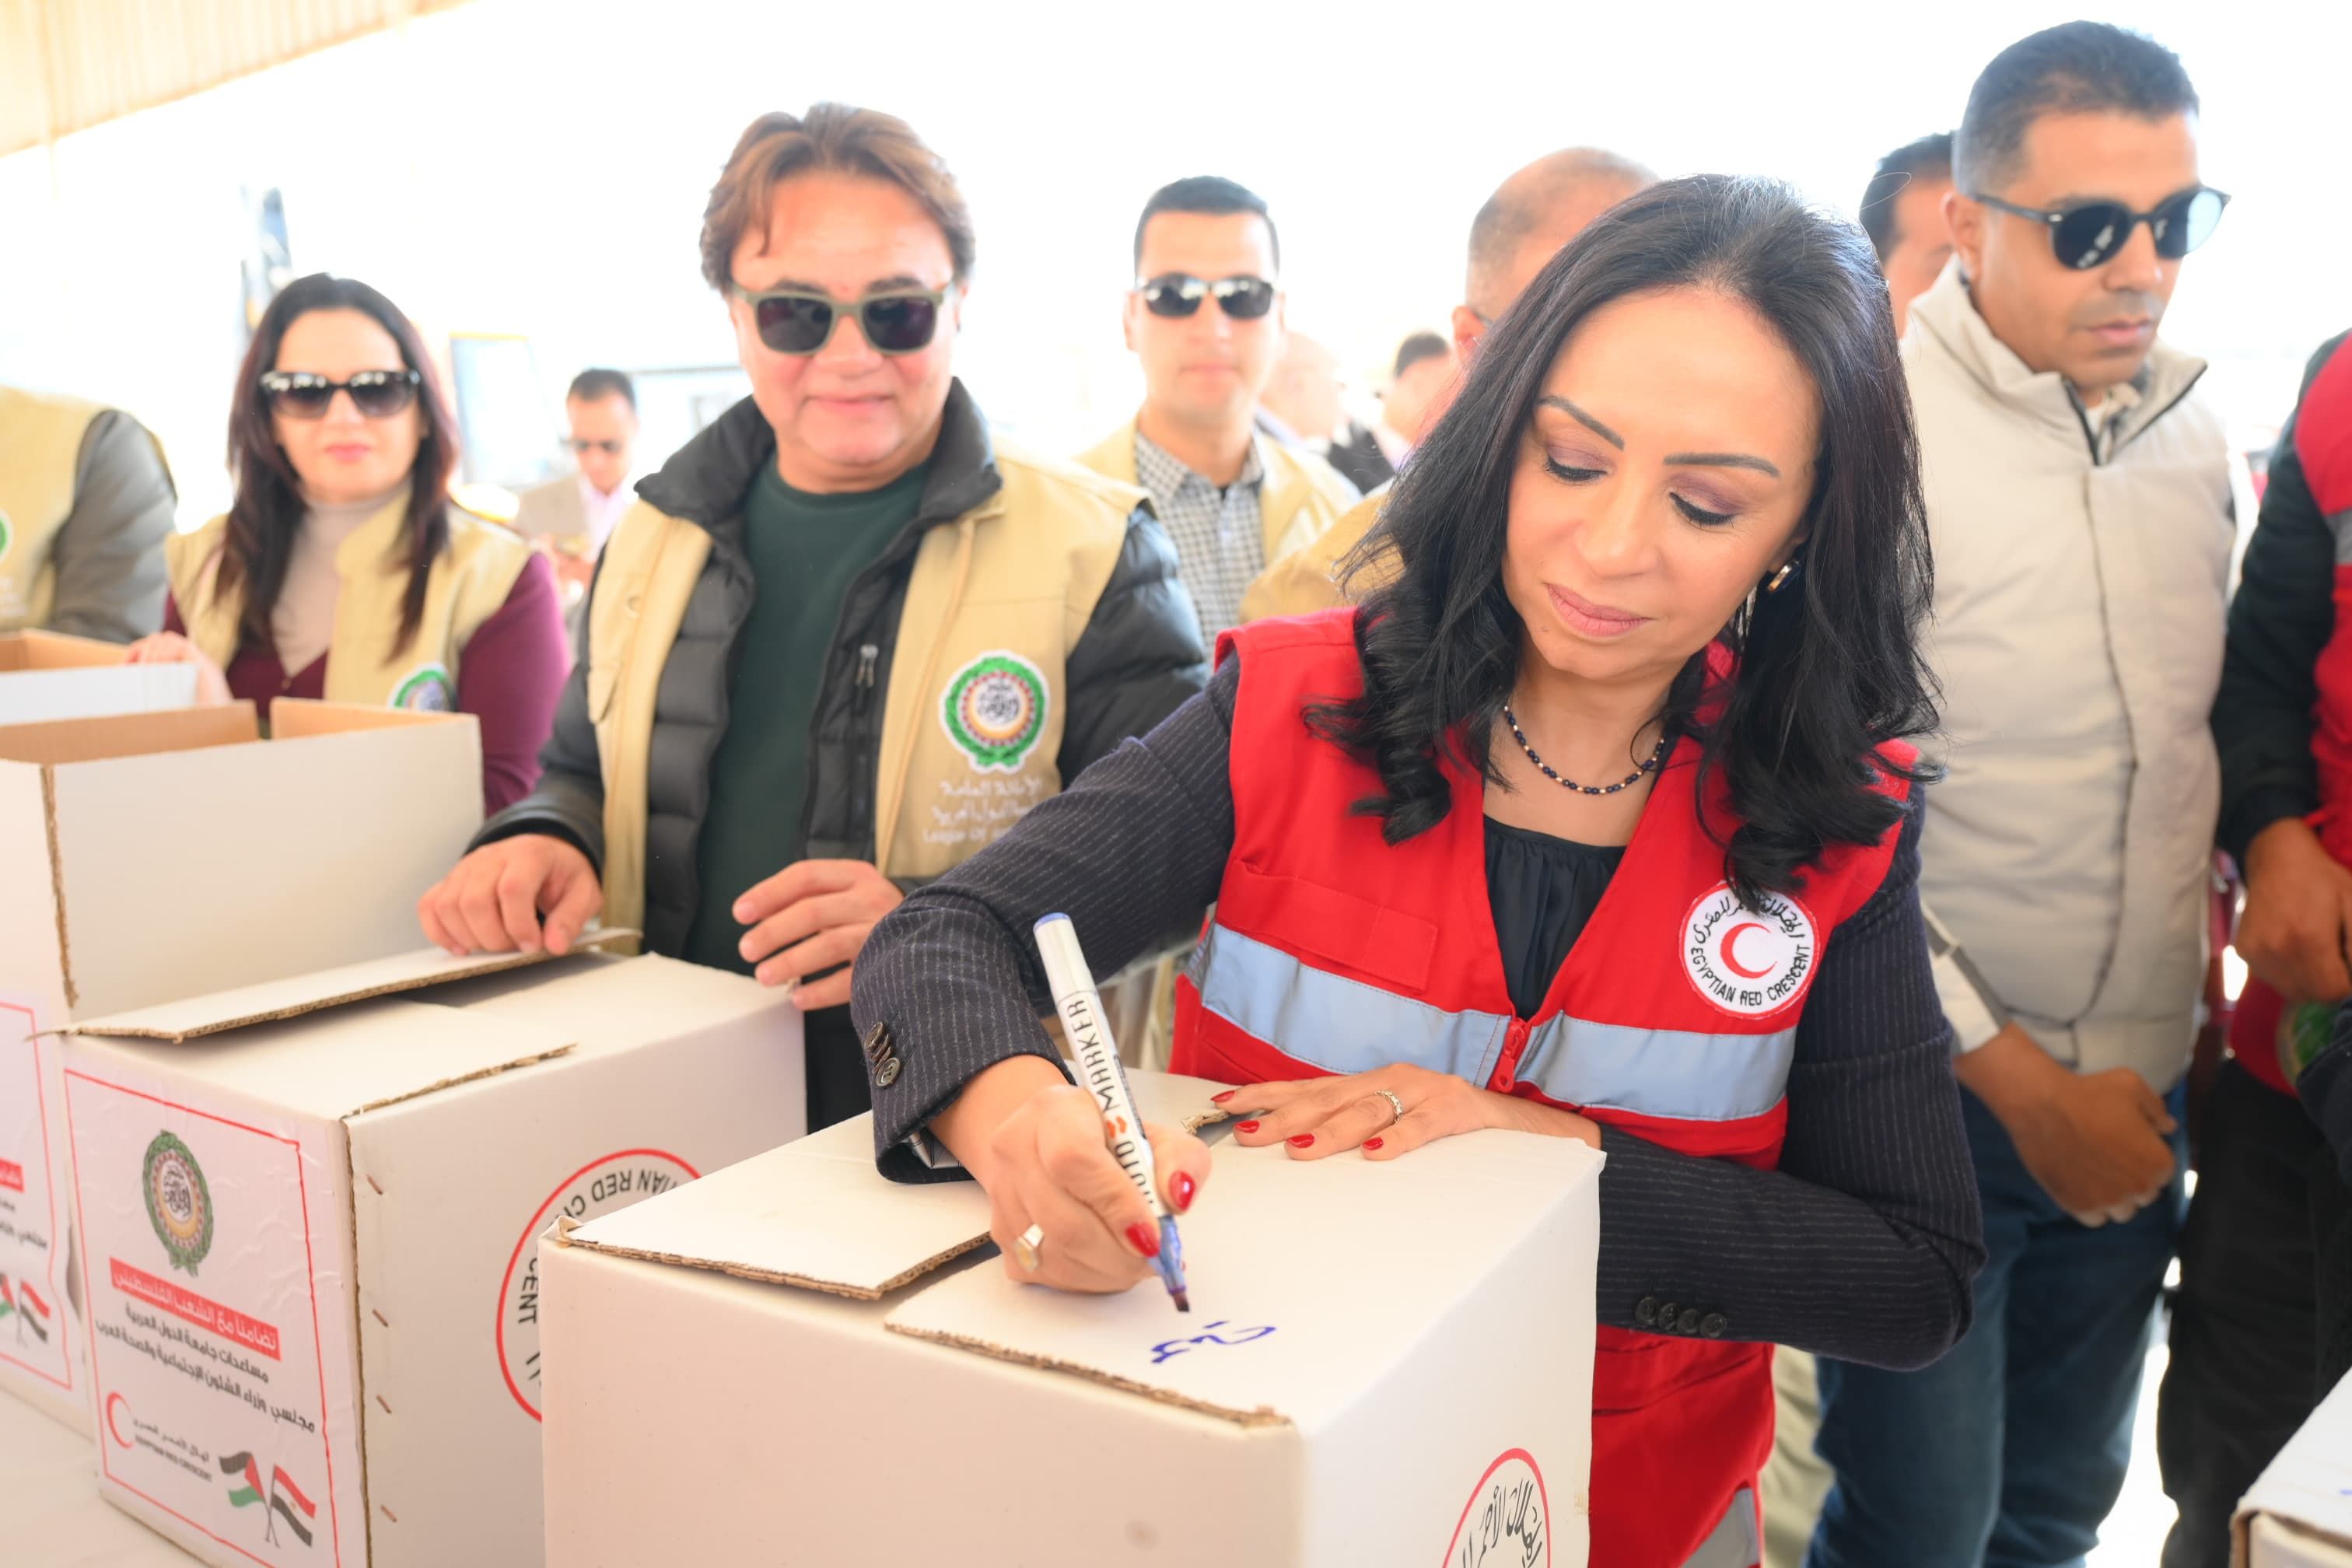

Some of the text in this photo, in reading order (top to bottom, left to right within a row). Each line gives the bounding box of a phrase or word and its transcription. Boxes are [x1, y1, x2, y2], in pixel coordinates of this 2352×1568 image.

[1691, 943, 1811, 1006] EGYPTIAN RED CRESCENT
[1069, 999, 1121, 1113] MARKER
[591, 1169, 631, 1202] RED
